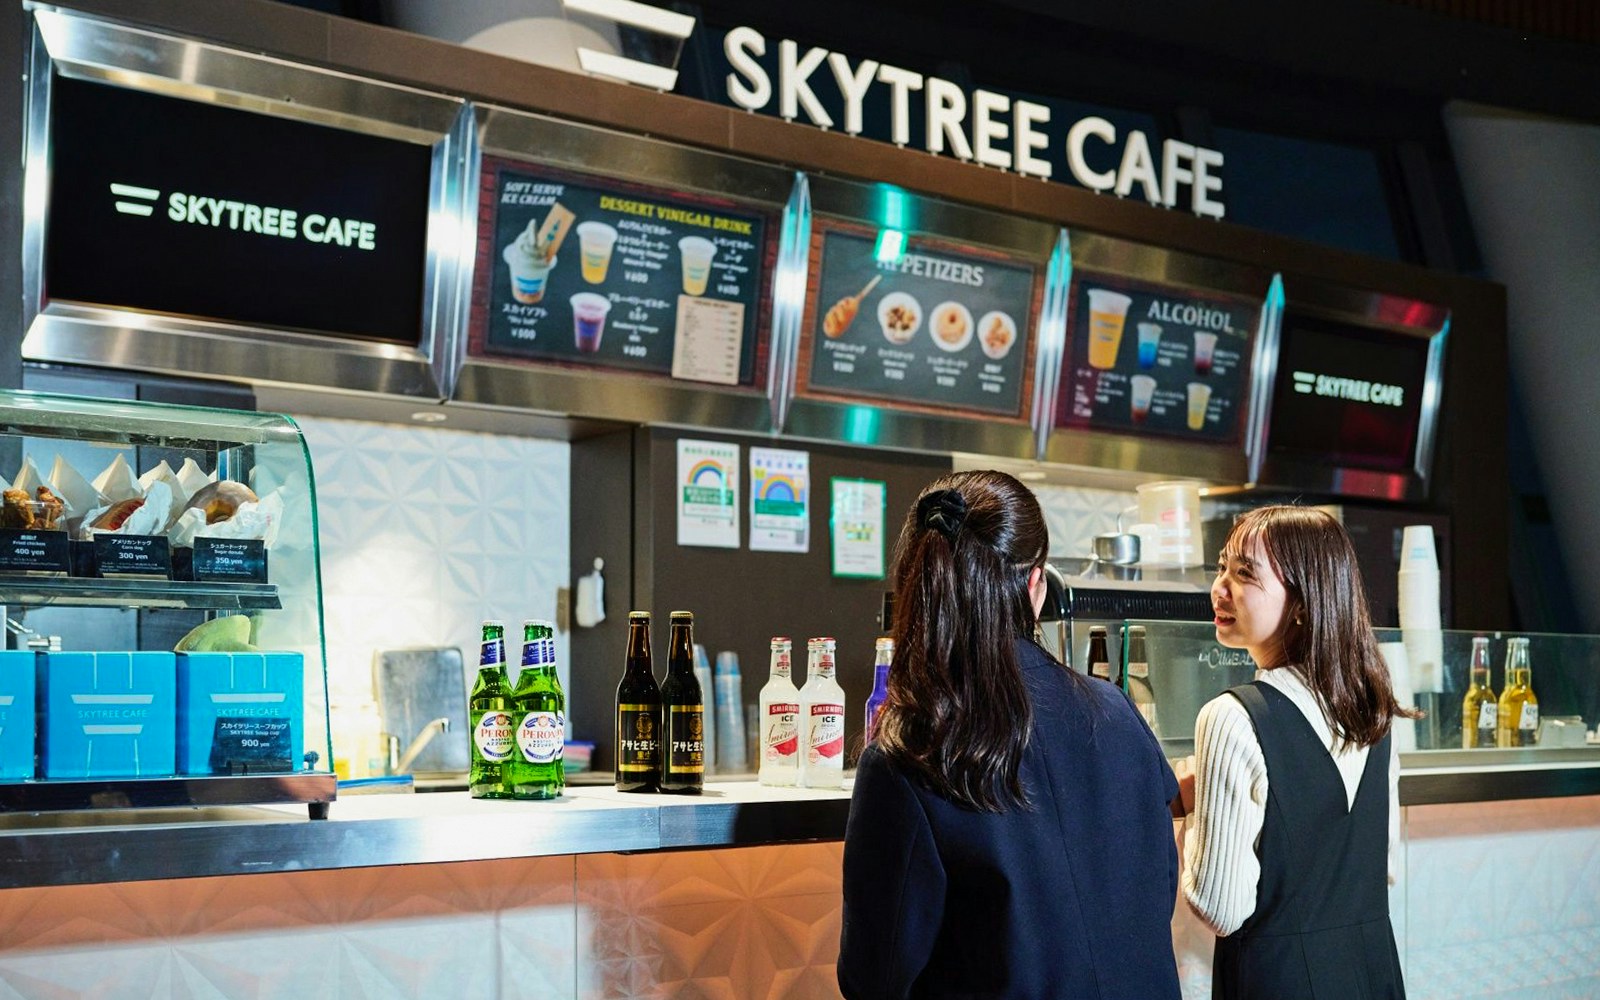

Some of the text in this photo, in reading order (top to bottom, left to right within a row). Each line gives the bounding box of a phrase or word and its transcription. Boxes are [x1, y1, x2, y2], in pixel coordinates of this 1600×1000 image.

[724, 26, 1225, 218] SKYTREE CAFE
[501, 193, 519, 204] ICE
[504, 181, 565, 196] SOFT SERVE
[168, 192, 376, 250] SKYTREE CAFE
[600, 195, 753, 236] DESSERT VINEGAR DRINK
[1147, 300, 1235, 333] ALCOHOL
[1315, 374, 1404, 407] SKYTREE CAFE
[78, 709, 148, 719] SKYTREE CAFE
[216, 708, 280, 717] SKYTREE CAFE
[241, 738, 259, 747] 900
